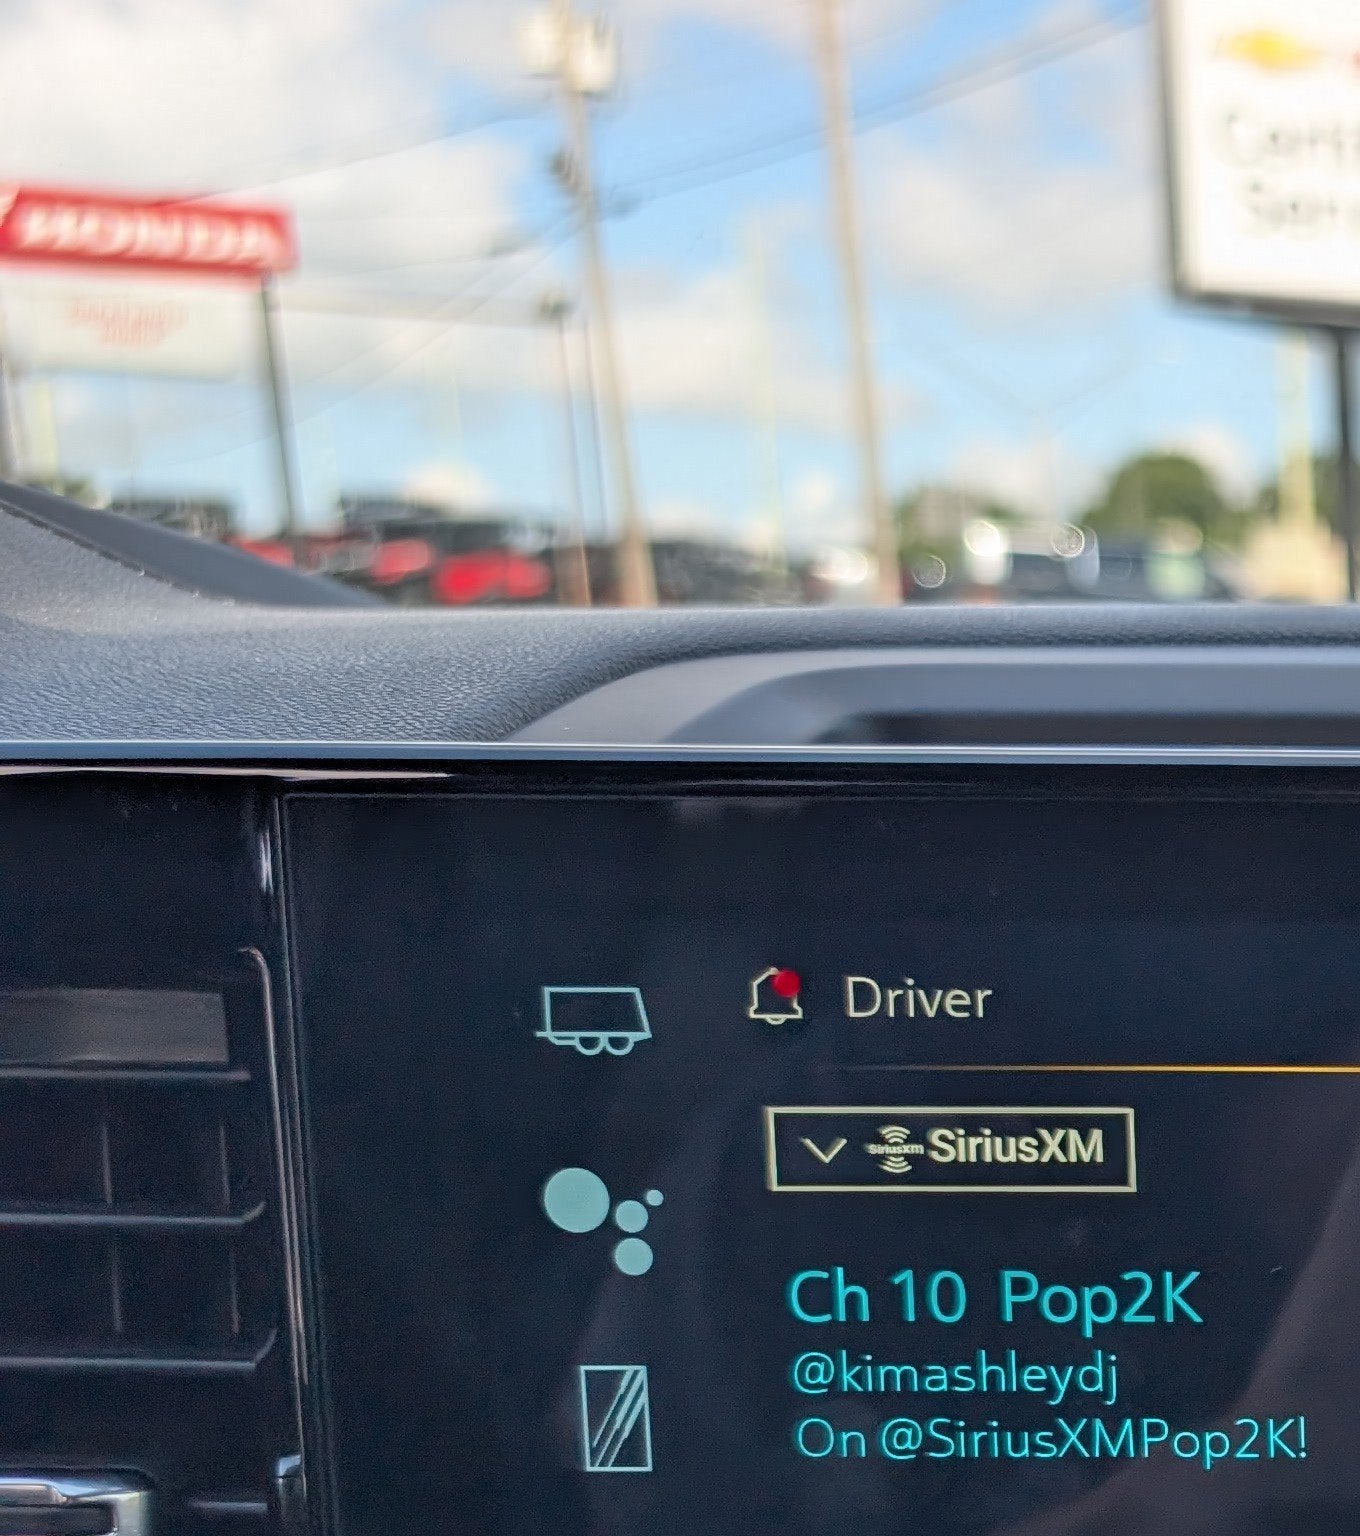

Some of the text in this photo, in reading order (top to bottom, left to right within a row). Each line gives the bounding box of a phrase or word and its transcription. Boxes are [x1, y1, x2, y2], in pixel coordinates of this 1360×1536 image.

[20, 203, 286, 268] HONDA
[845, 975, 994, 1019] Driver
[927, 1127, 1104, 1164] SiriusXM
[788, 1266, 1205, 1339] Ch 10 Pop2K
[791, 1349, 1118, 1407] @kimashleydj
[797, 1415, 1308, 1470] On @SiriusXMPop2K!
